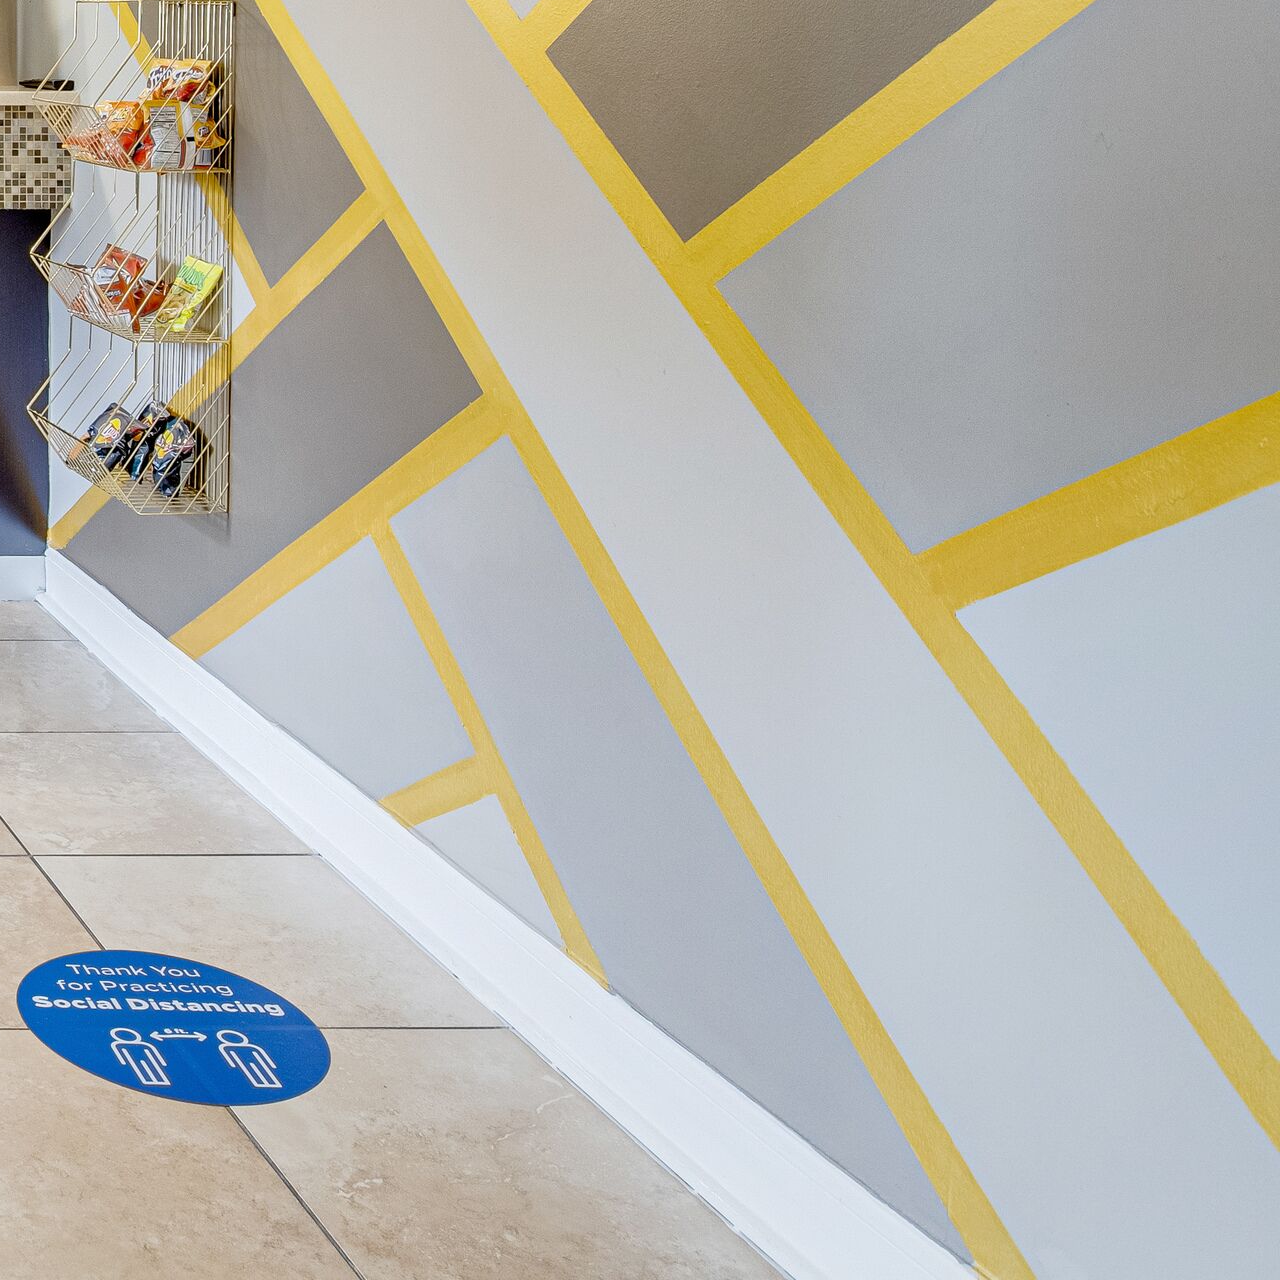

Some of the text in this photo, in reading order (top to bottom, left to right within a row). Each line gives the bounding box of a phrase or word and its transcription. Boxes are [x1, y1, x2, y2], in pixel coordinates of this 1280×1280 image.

[66, 963, 202, 978] Thank You
[56, 979, 234, 997] for Practicing
[31, 995, 286, 1016] Social Distancing
